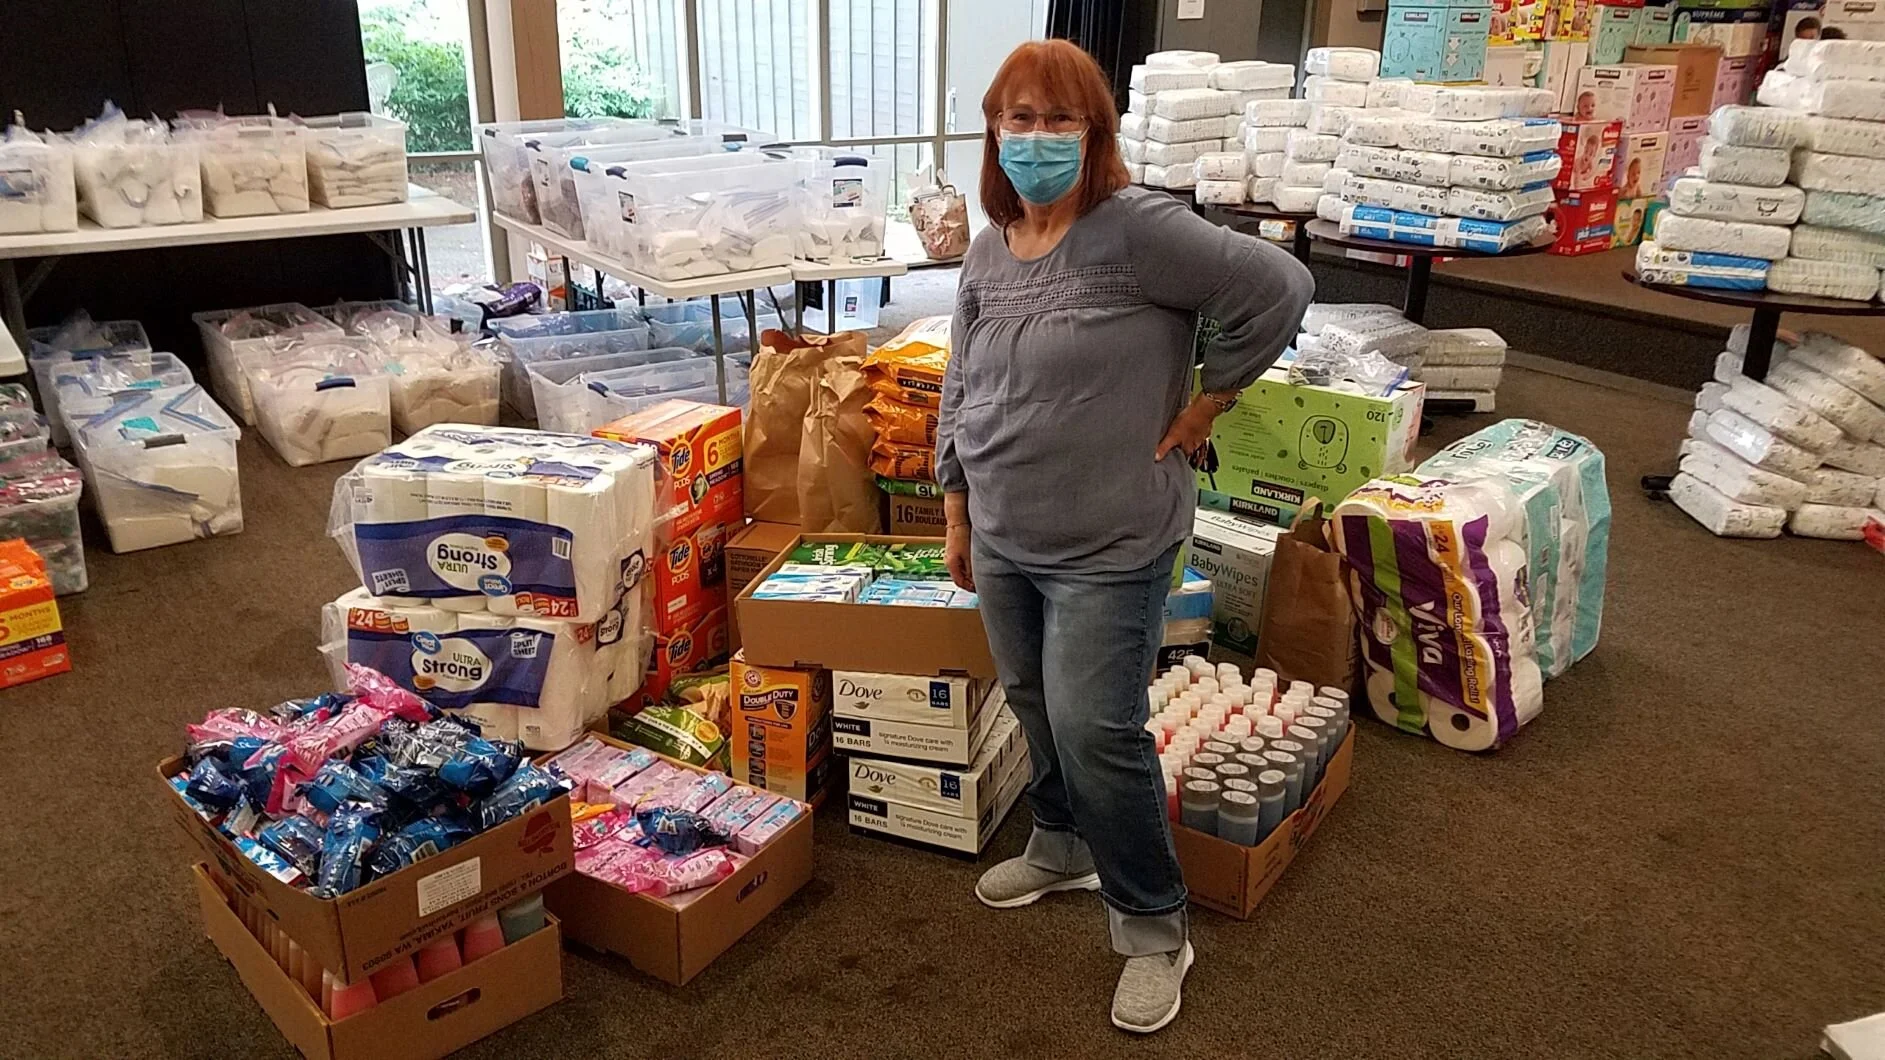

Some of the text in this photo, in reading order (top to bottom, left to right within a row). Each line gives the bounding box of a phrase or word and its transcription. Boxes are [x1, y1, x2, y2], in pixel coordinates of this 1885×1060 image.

[1366, 410, 1386, 423] 120
[671, 447, 691, 473] Tide
[707, 441, 719, 467] 6
[673, 476, 691, 491] PODS
[918, 485, 935, 497] 16
[1253, 486, 1301, 504] KIRKLAND
[896, 504, 914, 524] 16
[915, 507, 940, 517] FAMILY
[1232, 499, 1279, 517] KIRKLAND
[1434, 533, 1448, 554] 24
[436, 544, 497, 570] Strong
[669, 545, 690, 570] Tide
[436, 561, 468, 574] ULTRA
[375, 570, 405, 583] SHEETS
[384, 577, 408, 588] SPLIT
[671, 571, 690, 586] PODS
[551, 599, 569, 615] 24
[1451, 591, 1464, 613] Our
[356, 609, 374, 628] 24
[668, 637, 692, 664] Tide
[453, 652, 482, 666] ULTRA
[422, 658, 483, 681] Strong
[743, 694, 772, 705] DOUBLE
[772, 690, 794, 700] DUTY
[838, 679, 883, 700] Dove
[932, 689, 948, 699] 16
[835, 722, 861, 732] WHITE
[835, 736, 872, 748] 16 BARS
[908, 735, 924, 743] Dove
[854, 764, 896, 785] Dove
[854, 800, 878, 812] WHITE
[865, 816, 888, 828] BARS
[532, 861, 567, 885] BORTON
[497, 885, 519, 903] SONS
[394, 938, 412, 954] WA
